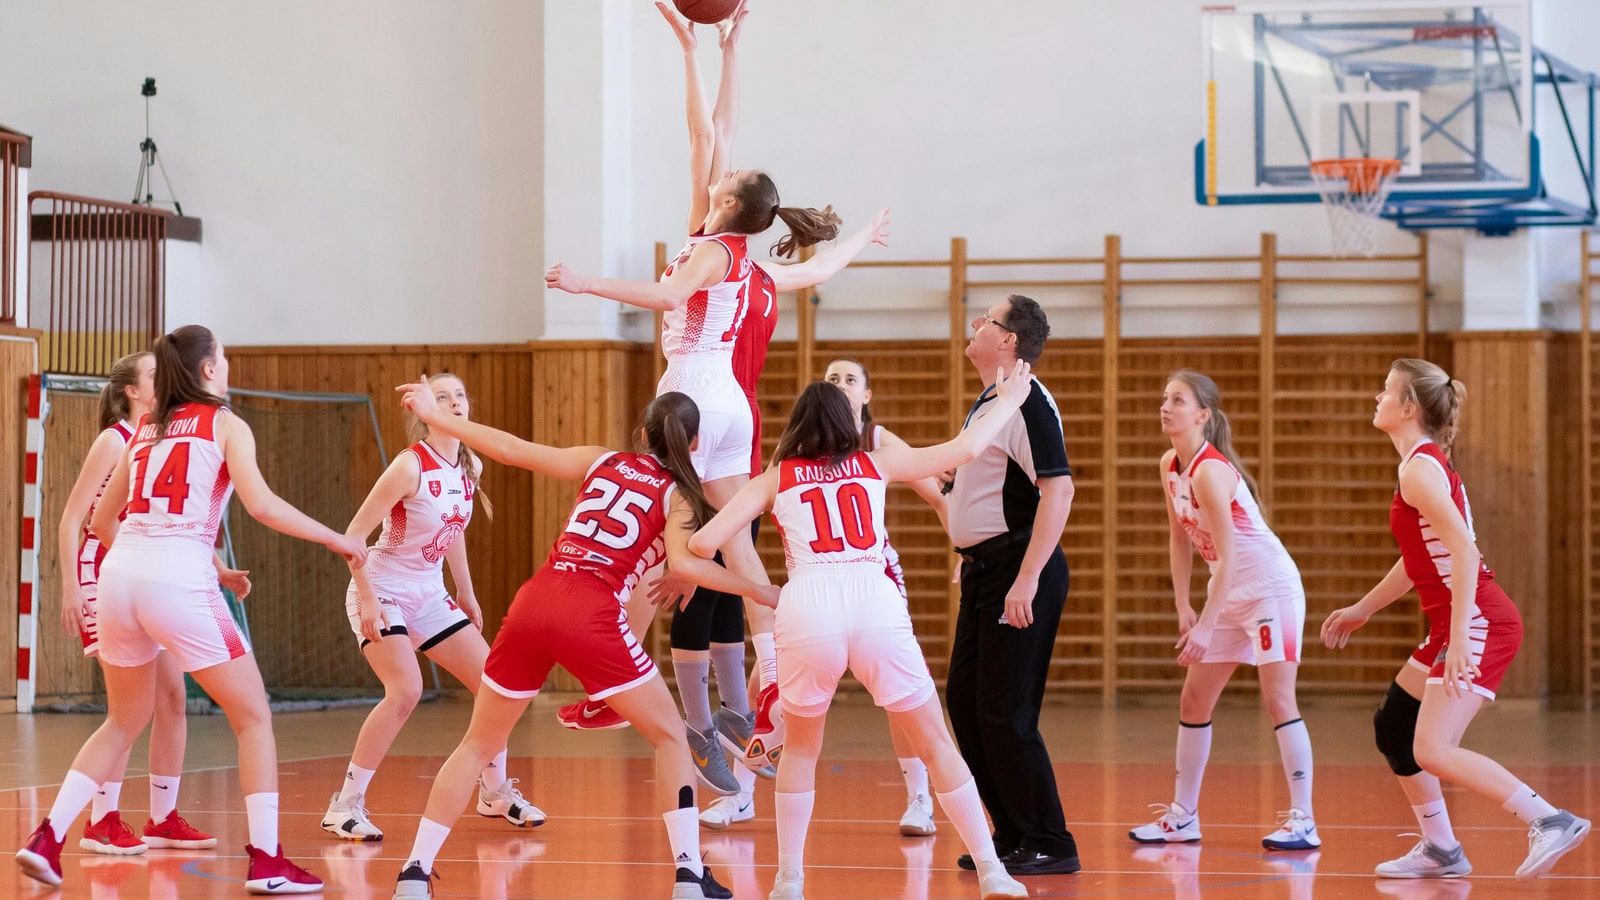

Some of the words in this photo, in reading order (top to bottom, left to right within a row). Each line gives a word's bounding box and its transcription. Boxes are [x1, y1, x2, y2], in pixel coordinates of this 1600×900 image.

[136, 414, 200, 442] HOLKOVÁ
[127, 441, 191, 515] 14
[614, 460, 666, 489] legrand
[564, 477, 654, 550] 25
[800, 482, 877, 553] 10
[1260, 624, 1273, 651] 8
